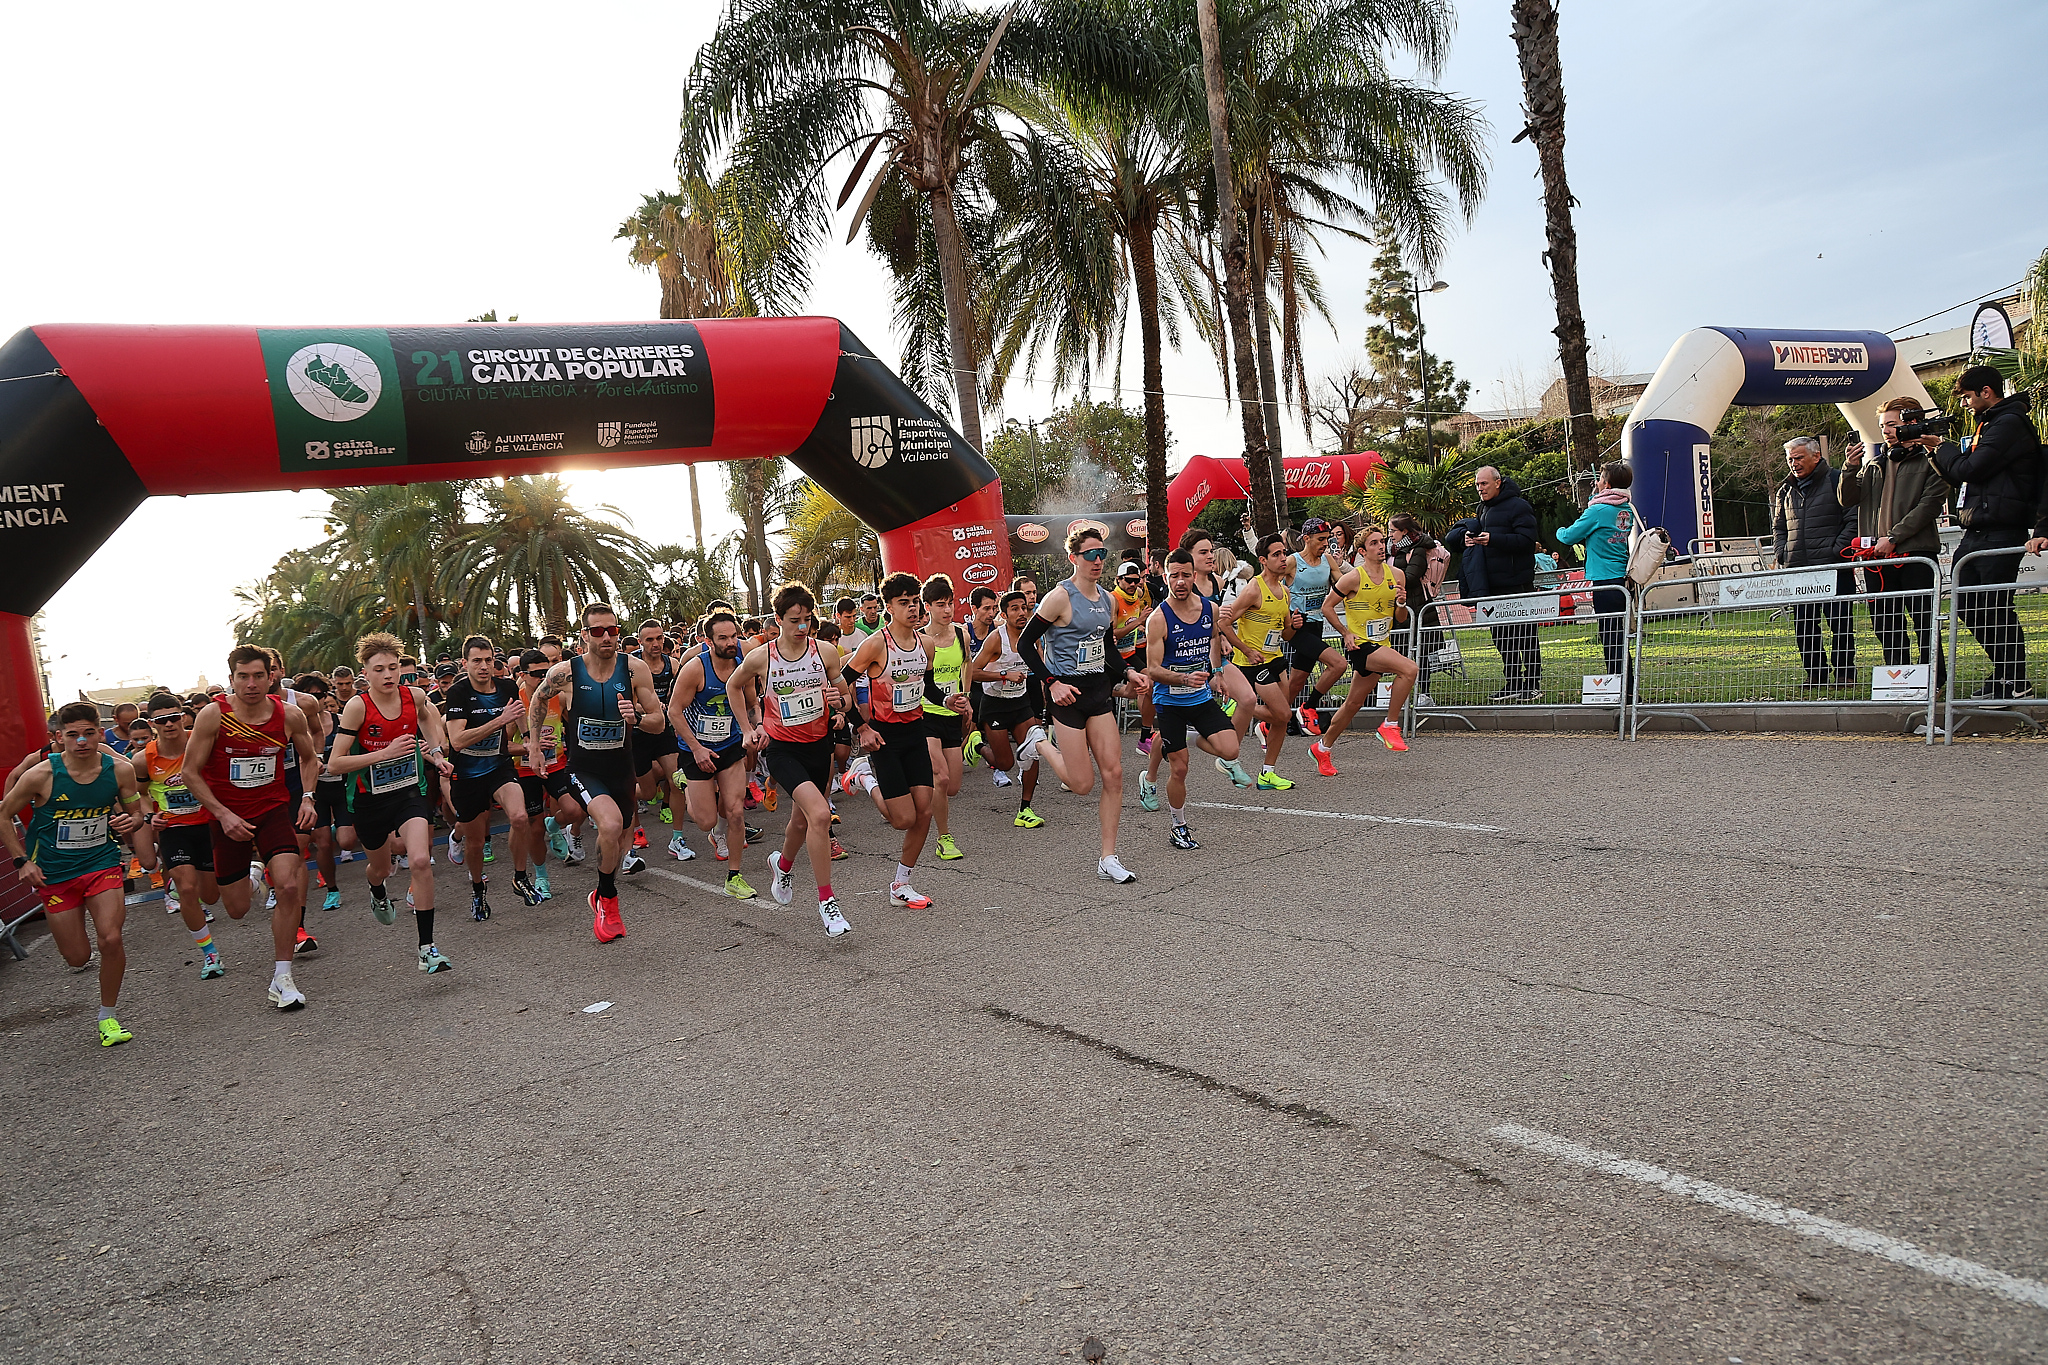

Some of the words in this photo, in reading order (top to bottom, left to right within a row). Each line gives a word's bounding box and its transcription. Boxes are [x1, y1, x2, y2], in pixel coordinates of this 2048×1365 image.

[1790, 346, 1863, 364] INTERSPORT
[411, 350, 465, 386] 21
[467, 348, 551, 363] CIRCUIT
[556, 347, 585, 361] DE
[586, 344, 694, 361] CARRERES
[471, 362, 563, 384] CAIXA
[565, 358, 687, 380] POPULAR
[1784, 374, 1855, 387] www.intersport.es
[418, 387, 473, 402] CIUTAT
[477, 386, 499, 400] DE
[501, 383, 578, 399] VALÈNCIA
[596, 381, 621, 398] Por
[636, 379, 698, 396] Autismo
[624, 420, 657, 429] Fundació
[897, 417, 942, 428] Fundació
[495, 432, 565, 444] AJUNTAMENT
[623, 433, 659, 441] Municipal
[624, 427, 658, 436] Esportiva
[898, 428, 948, 441] Esportiva
[333, 439, 374, 450] caixa
[494, 445, 510, 453] DE
[512, 441, 564, 452] VALÈNCIA
[900, 438, 952, 451] Municipal
[333, 446, 396, 459] popular
[900, 450, 949, 463] València
[1698, 451, 1715, 555] TERSPORT
[965, 525, 985, 533] caixa
[966, 529, 993, 539] popular
[1021, 529, 1046, 537] Serrano
[971, 545, 997, 553] TRINIDAD
[967, 569, 995, 580] Serrano
[1747, 578, 1785, 589] VALENCIA
[1745, 588, 1776, 600] CIUDAD
[1777, 587, 1793, 597] DEL
[1795, 584, 1831, 596] RUNNING
[1495, 610, 1516, 619] CIUDAD
[1517, 608, 1529, 617] DEL
[1530, 606, 1556, 616] RUNNING
[1496, 602, 1523, 610] VALENCIA
[1178, 636, 1210, 649] POBLATS
[772, 677, 821, 690] ECOlógicos
[909, 686, 920, 698] 14
[797, 696, 814, 709] 10
[581, 725, 618, 738] 2371
[711, 721, 725, 731] 52
[249, 762, 266, 774] 76
[375, 762, 410, 781] 2137
[81, 823, 98, 836] 17
